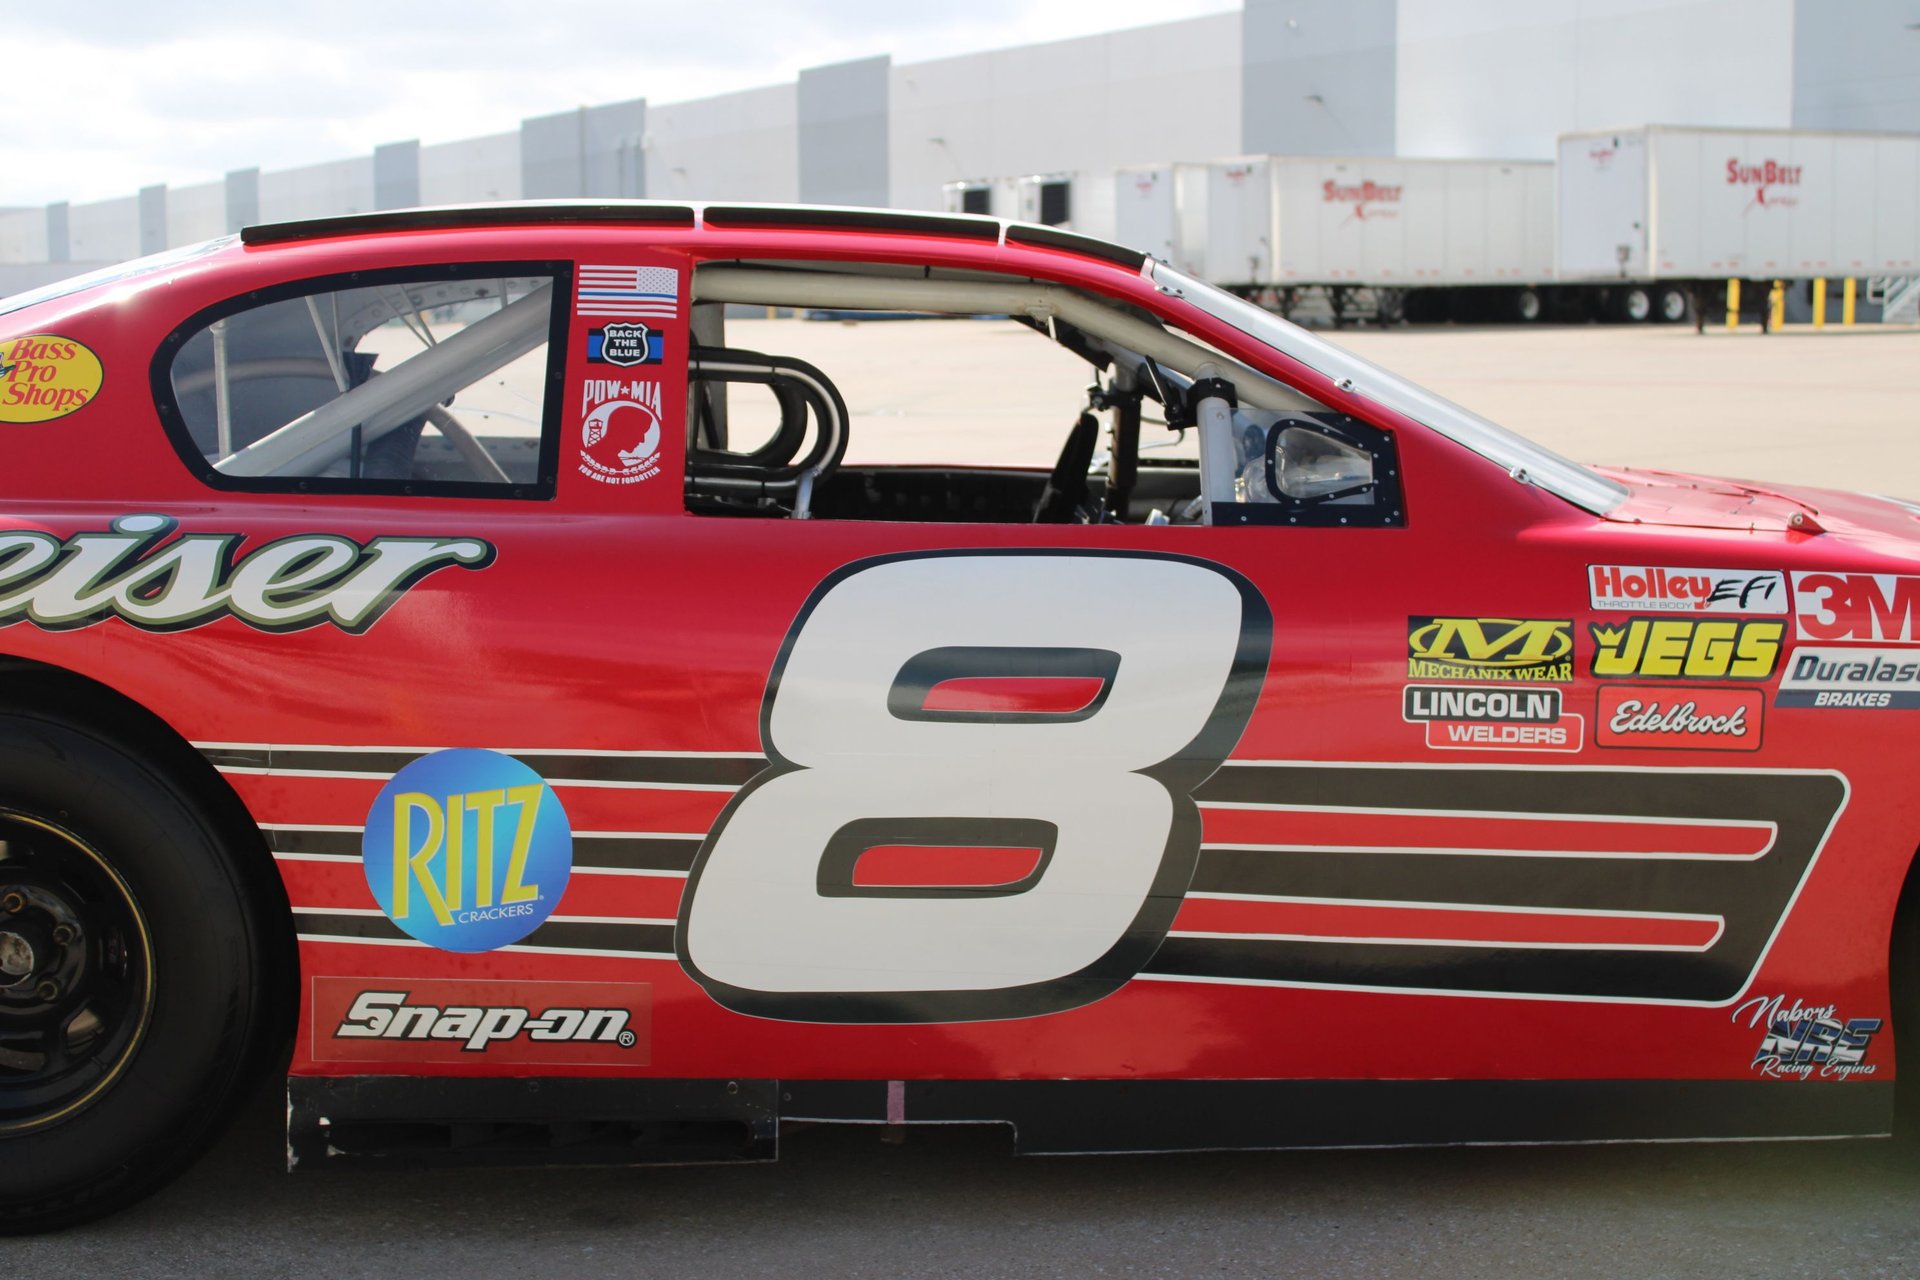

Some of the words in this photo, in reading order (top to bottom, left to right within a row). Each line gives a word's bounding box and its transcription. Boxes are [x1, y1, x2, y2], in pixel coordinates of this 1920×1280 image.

[609, 330, 642, 338] BACK
[614, 339, 637, 347] THE
[8, 339, 77, 361] Bass
[609, 349, 640, 357] BLUE
[6, 360, 57, 383] Pro
[2, 382, 89, 411] Shops
[578, 464, 592, 477] YOU
[605, 476, 620, 485] NOT
[1593, 567, 1712, 610] Holley
[1706, 576, 1777, 609] EFI
[1597, 600, 1657, 609] THROTTLE
[1658, 602, 1693, 610] BODY
[1797, 573, 1920, 641] 3M
[1594, 620, 1784, 677] JEGS
[1407, 657, 1513, 681] MECHANIX
[1514, 662, 1574, 682] WEAR
[1791, 655, 1920, 682] Duralas
[1412, 690, 1552, 719] LINCOLN
[1814, 691, 1892, 707] BRAKES
[1609, 699, 1748, 737] Edelbrock
[1447, 725, 1568, 745] WELDERS
[675, 547, 1273, 1024] 8
[392, 782, 546, 926] RITZ
[458, 903, 534, 925] CRACKERS
[335, 990, 630, 1051] Snap-on
[1731, 993, 1837, 1029] Nabors
[1751, 1055, 1815, 1081] Racing
[1820, 1056, 1877, 1081] Engines
